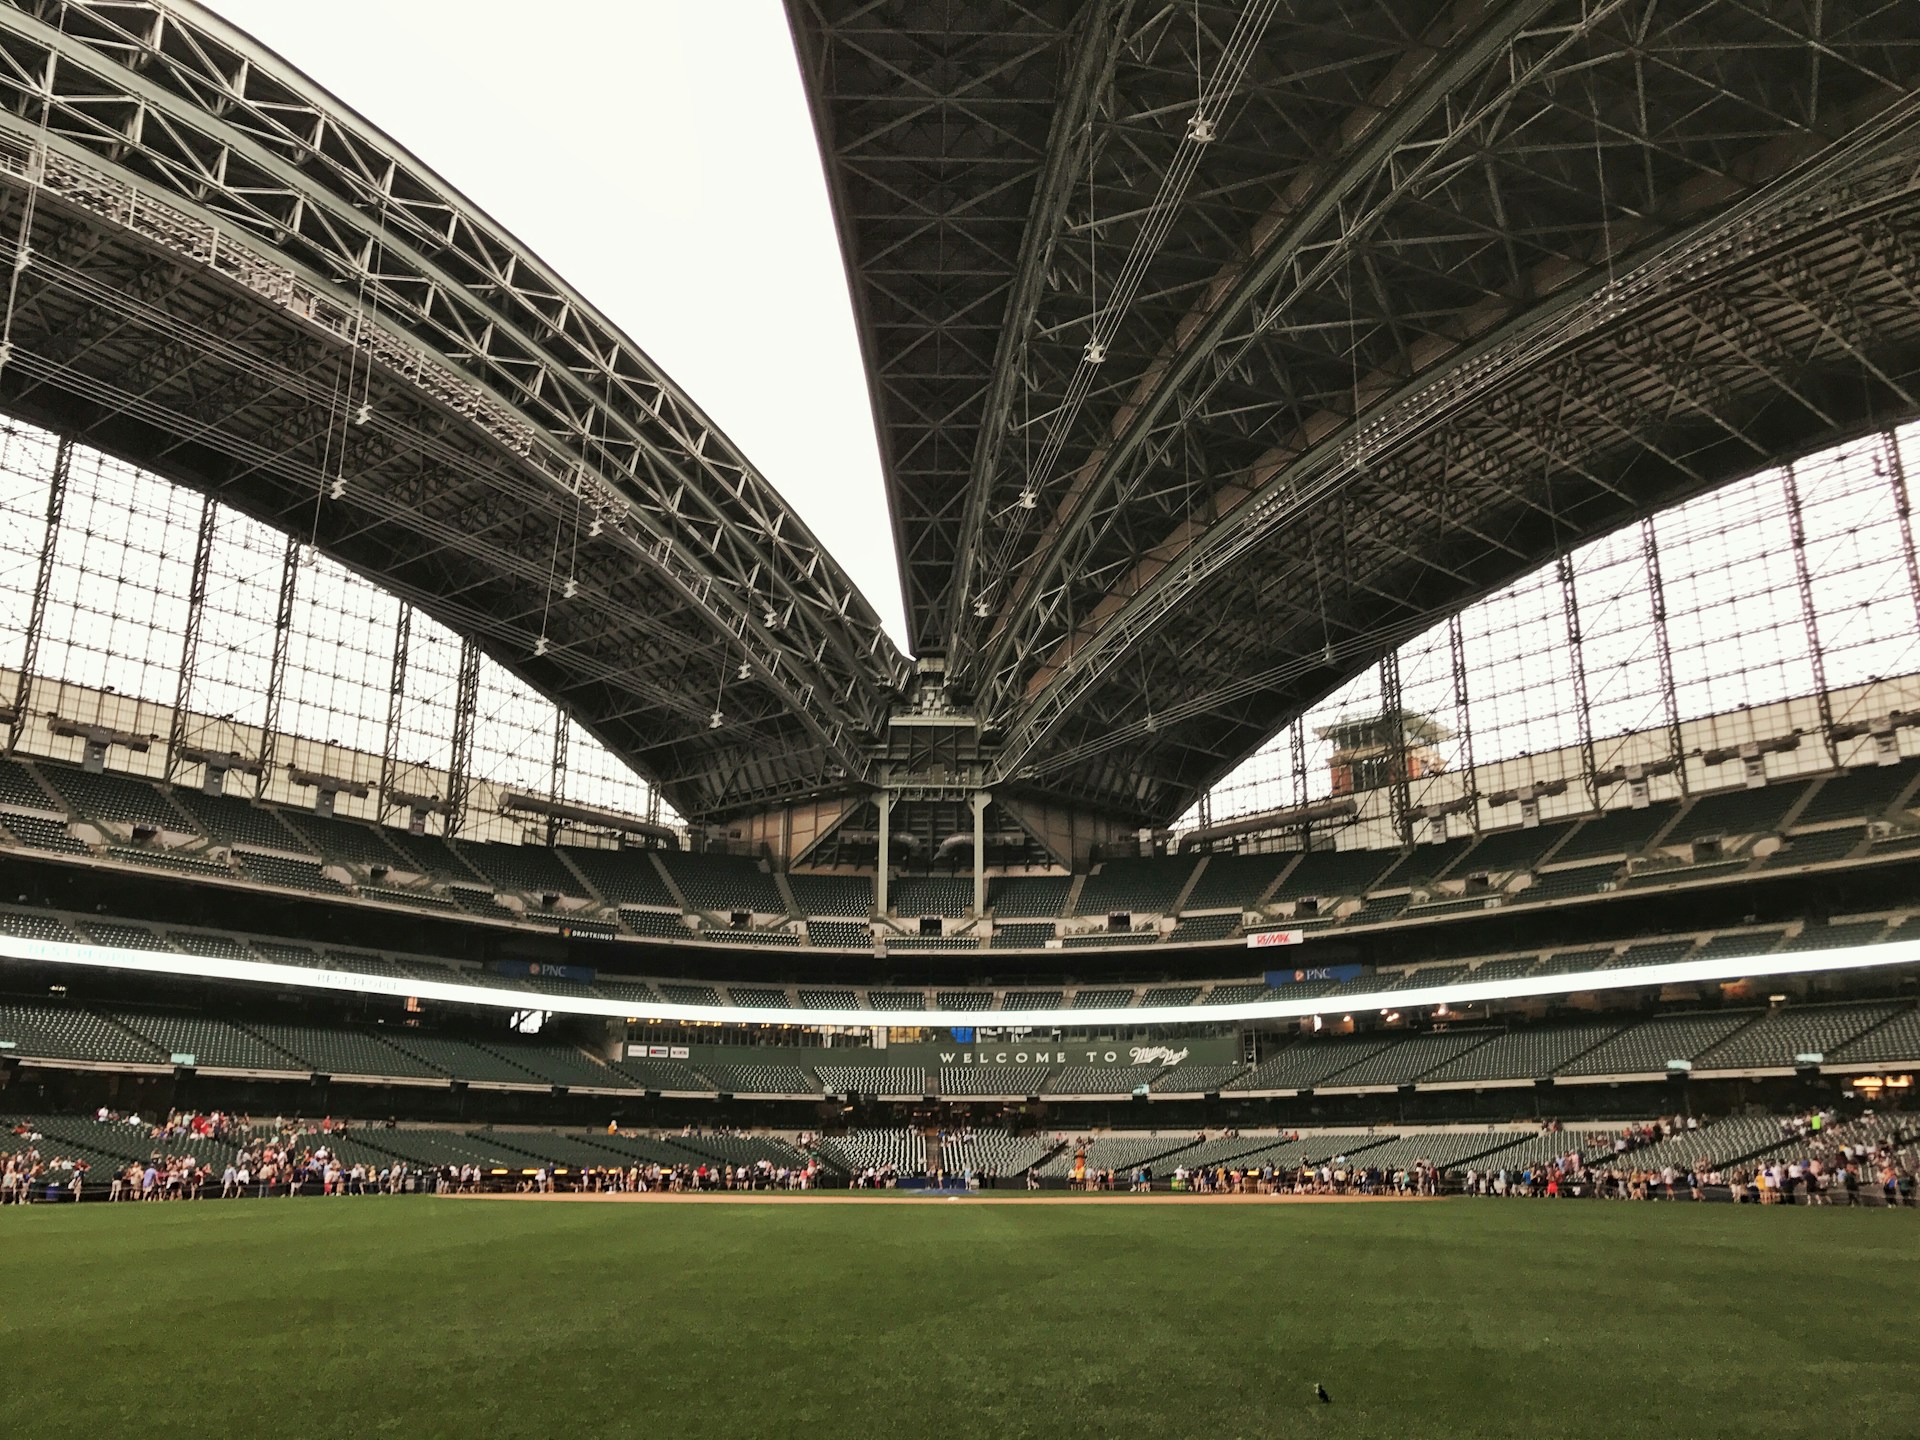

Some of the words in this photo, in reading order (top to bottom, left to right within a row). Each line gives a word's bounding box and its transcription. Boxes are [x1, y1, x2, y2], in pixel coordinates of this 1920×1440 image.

[572, 930, 613, 941] DRAFTKINGS
[1256, 933, 1290, 945] RE/MAX
[542, 964, 567, 977] PNC
[1306, 968, 1331, 980] PNC
[939, 1052, 1066, 1064] WELCOME
[1086, 1051, 1117, 1063] TO
[1129, 1046, 1167, 1066] Miller
[1158, 1046, 1190, 1068] Park
